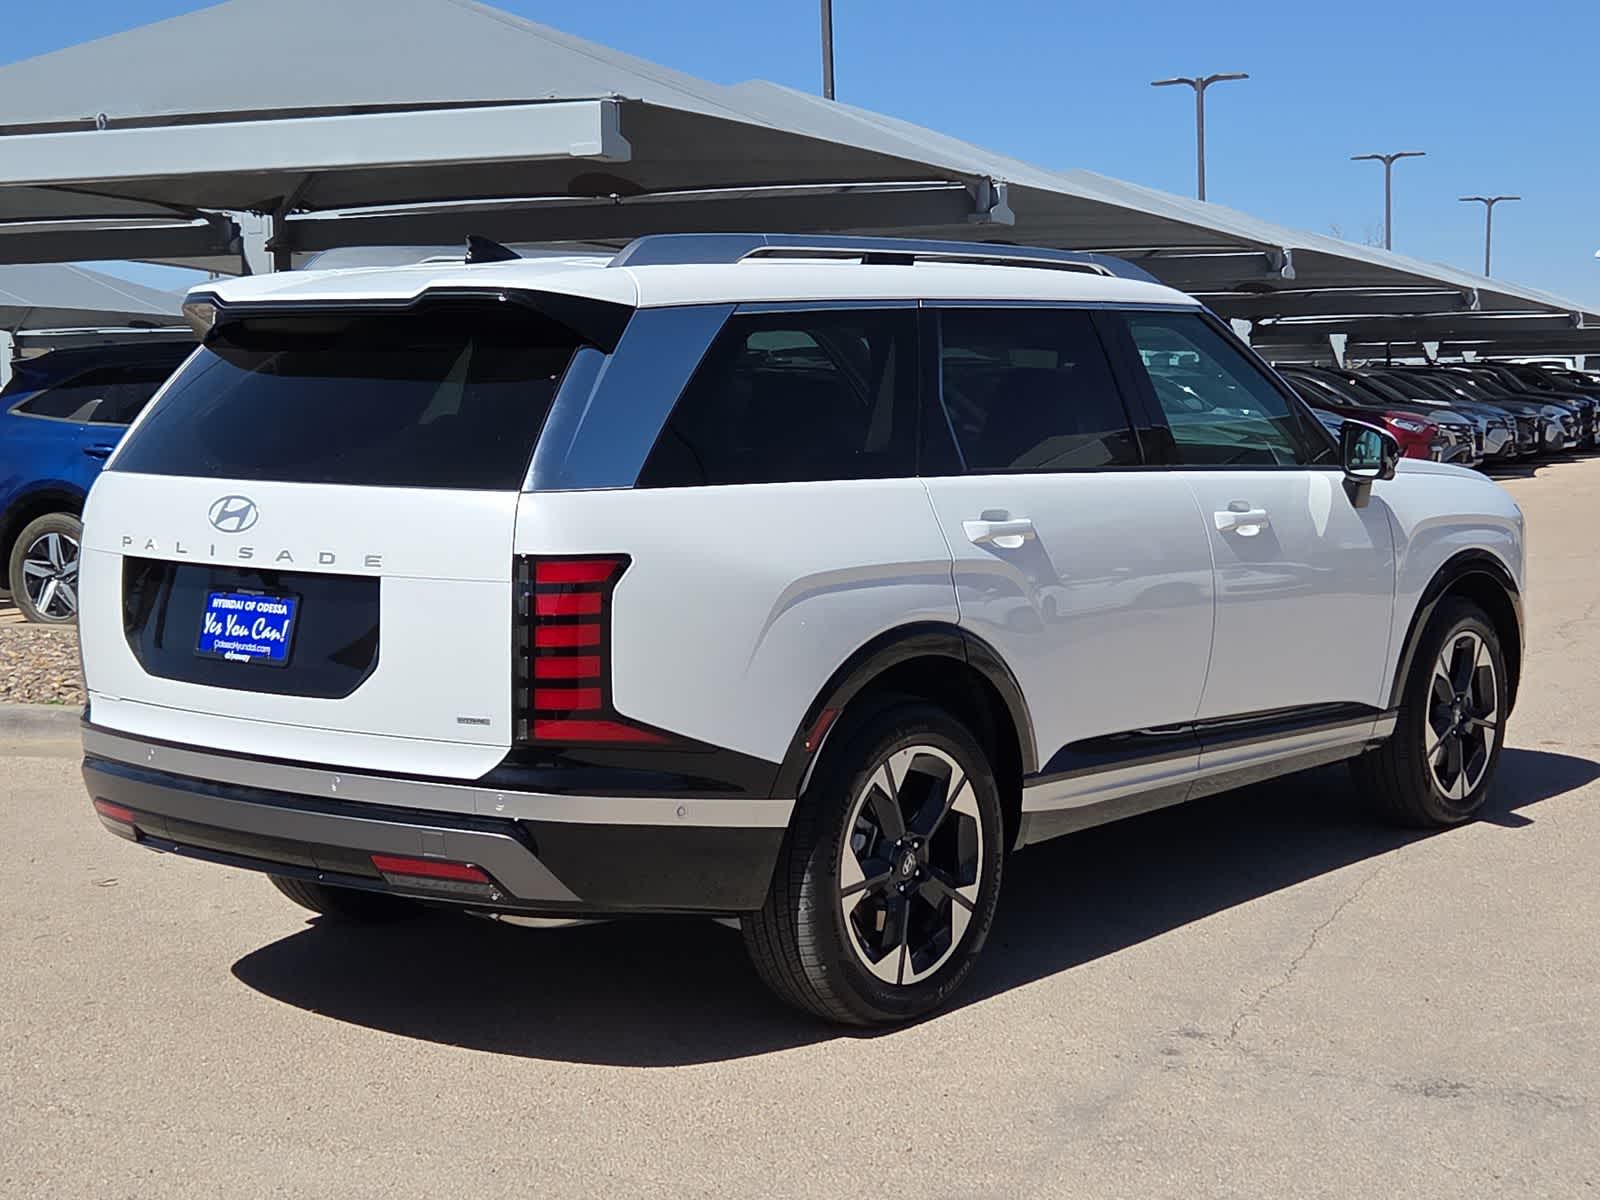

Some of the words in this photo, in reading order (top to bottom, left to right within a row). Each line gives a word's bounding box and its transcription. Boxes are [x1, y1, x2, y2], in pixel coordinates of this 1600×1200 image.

[122, 536, 382, 567] PALISADE
[212, 598, 244, 610] HYUNDAI
[244, 601, 257, 612] OF
[256, 602, 288, 615] ODESSA
[203, 612, 223, 636] Yes
[225, 614, 249, 637] You
[251, 617, 290, 643] Can!
